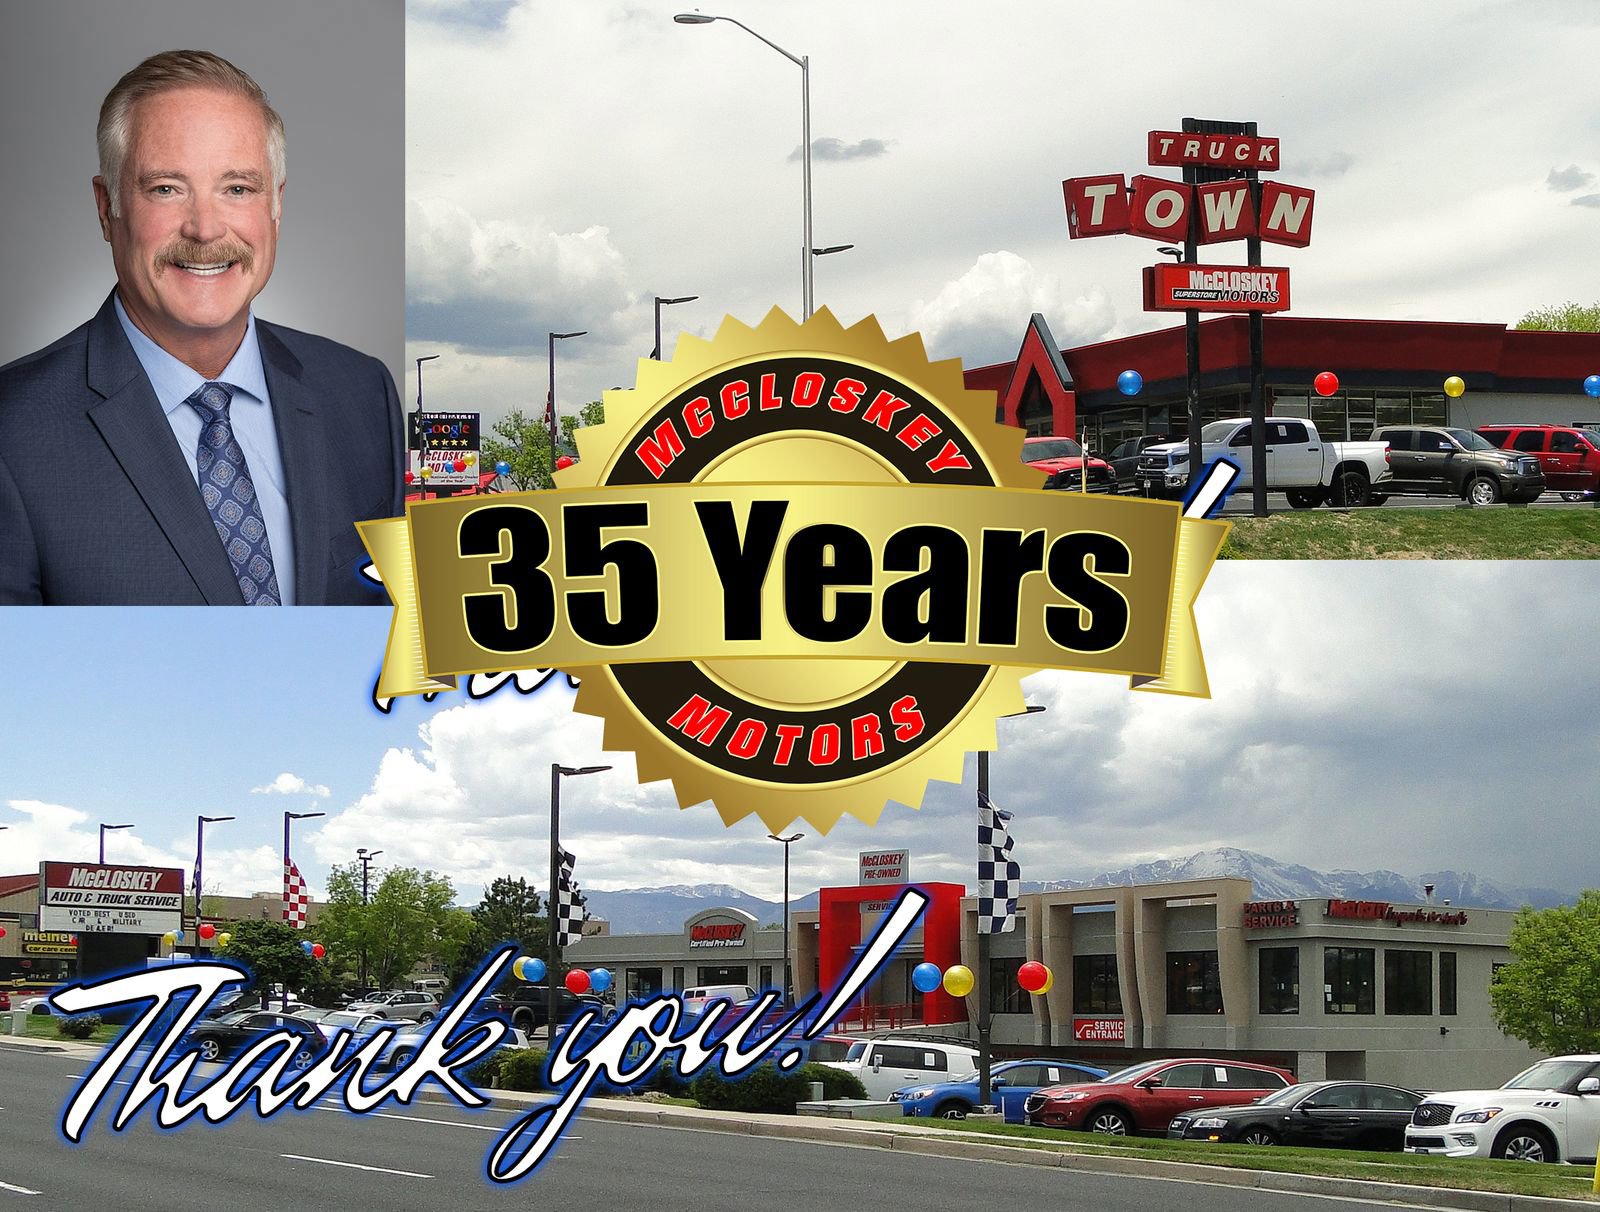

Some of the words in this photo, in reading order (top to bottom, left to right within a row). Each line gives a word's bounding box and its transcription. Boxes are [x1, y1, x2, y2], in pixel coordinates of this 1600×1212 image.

[1159, 138, 1276, 162] TRUCK
[1083, 183, 1311, 235] TOWN
[1189, 270, 1279, 292] McCLOSKEY
[1173, 290, 1218, 300] SUPERSTORE
[1217, 289, 1279, 304] MOTORS
[861, 853, 904, 867] McCLOSKEY
[68, 867, 163, 891] McCLOSKEY
[864, 868, 901, 879] PRE-OWNED
[50, 891, 83, 904] AUTO
[84, 892, 94, 903] &
[97, 893, 131, 905] TRUCK
[133, 895, 179, 907] SERVICE
[68, 909, 91, 917] VOTED
[1244, 914, 1296, 929] SERVICE
[1094, 1021, 1125, 1030] SERVIC
[1086, 1030, 1126, 1039] ENTRANC
